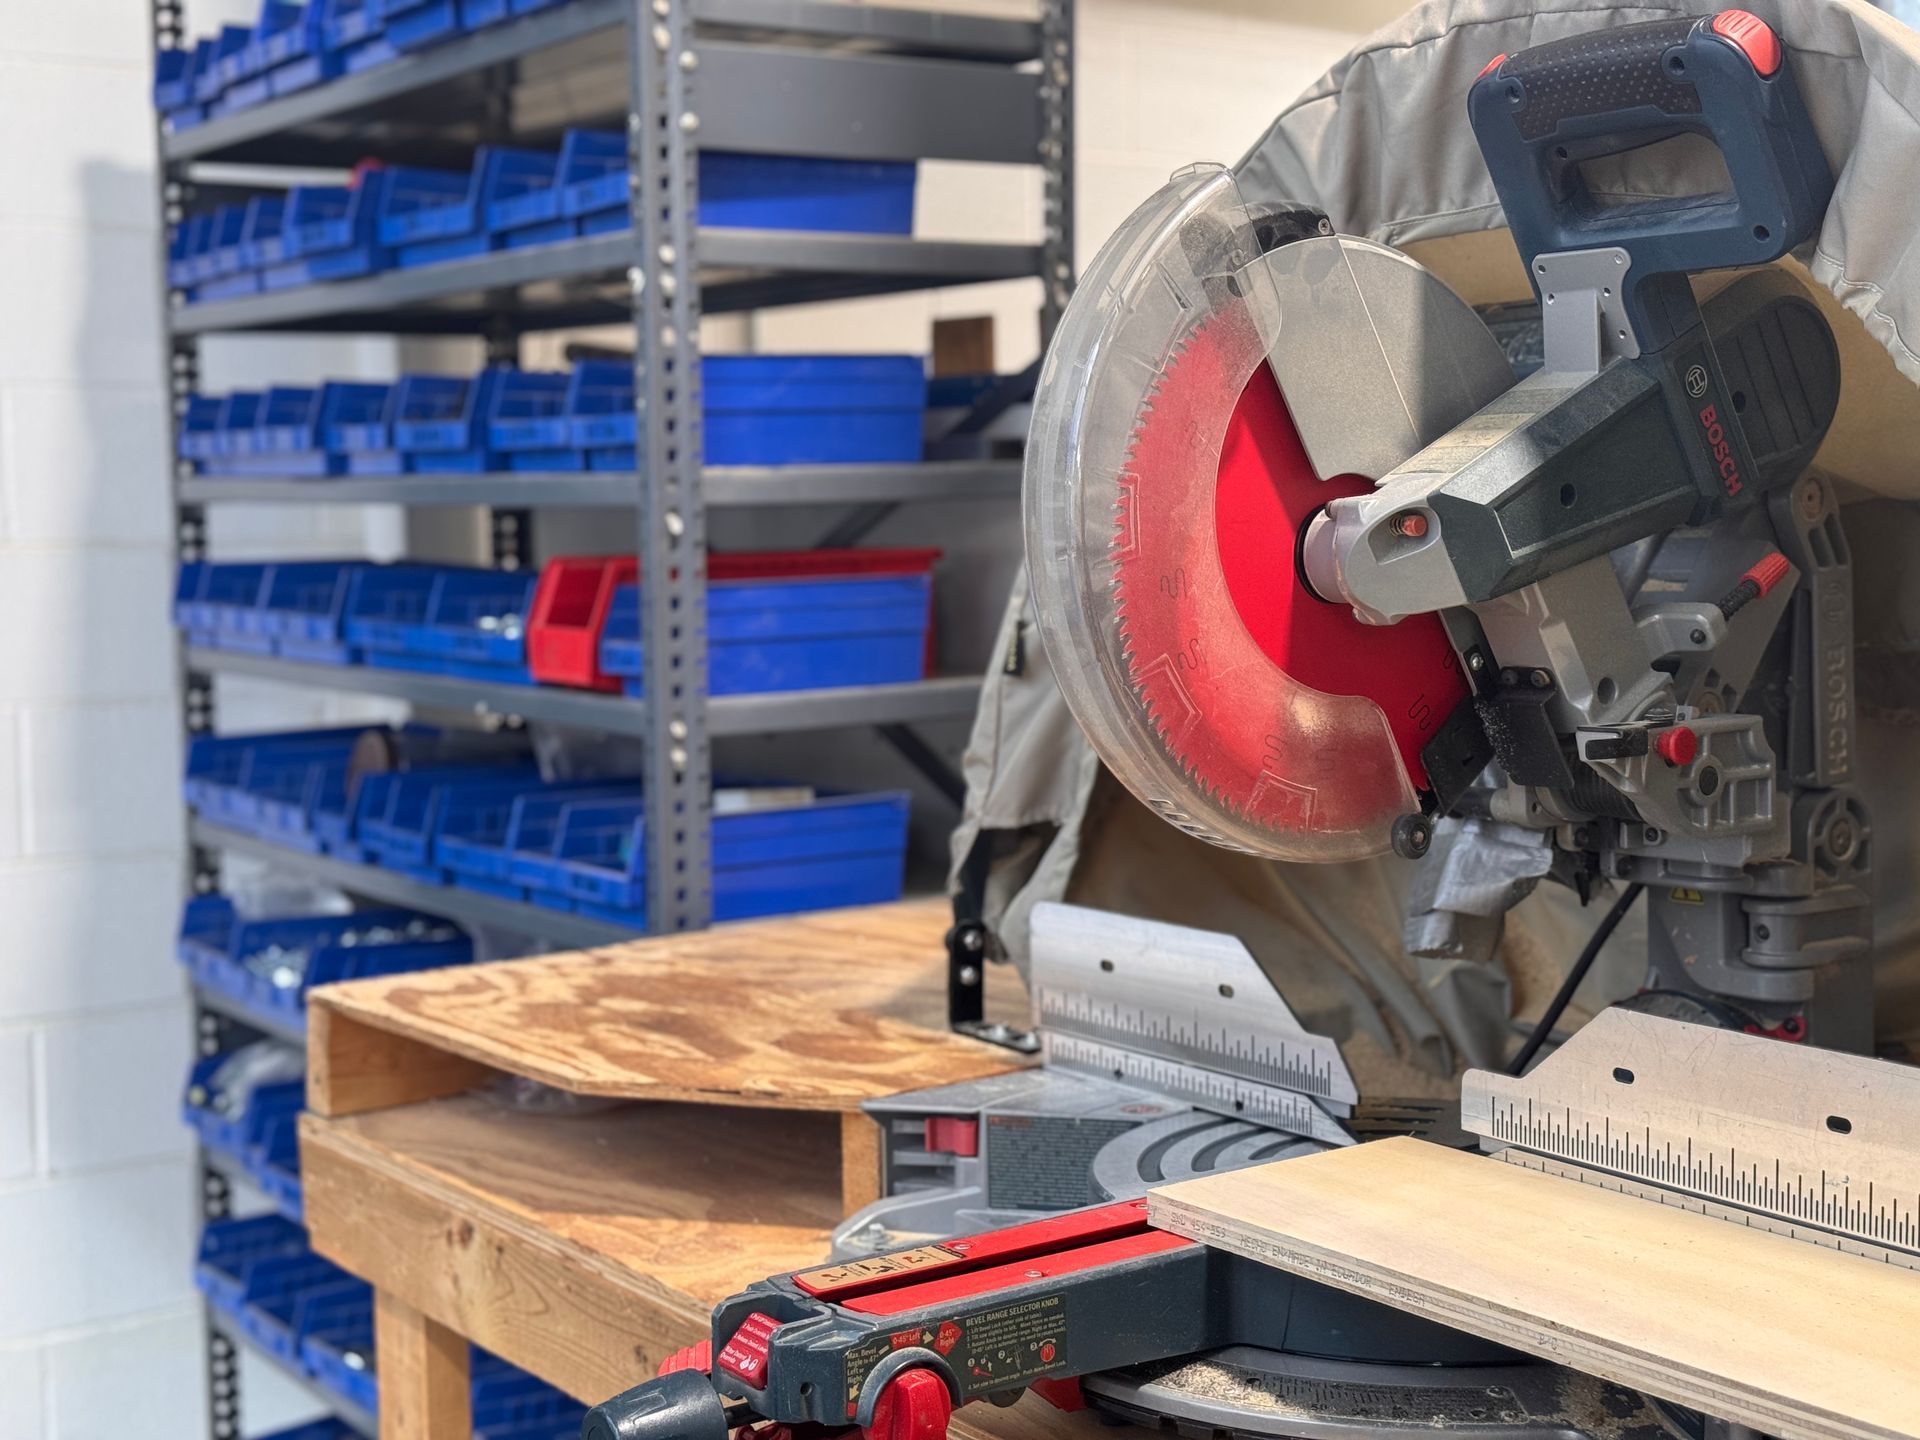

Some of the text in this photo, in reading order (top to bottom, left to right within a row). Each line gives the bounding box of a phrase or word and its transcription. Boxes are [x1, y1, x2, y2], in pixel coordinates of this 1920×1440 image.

[1700, 403, 1743, 496] BOSCH
[1827, 647, 1848, 776] BOSCH
[1170, 1211, 1186, 1226] SKU
[966, 1297, 1058, 1327] BEVEL RANGE SELECTOR KNOB
[910, 1332, 920, 1340] Left
[940, 1338, 954, 1347] Right
[848, 1346, 877, 1360] Max. Bevel
[847, 1359, 863, 1368] Angle
[847, 1367, 858, 1376] Left
